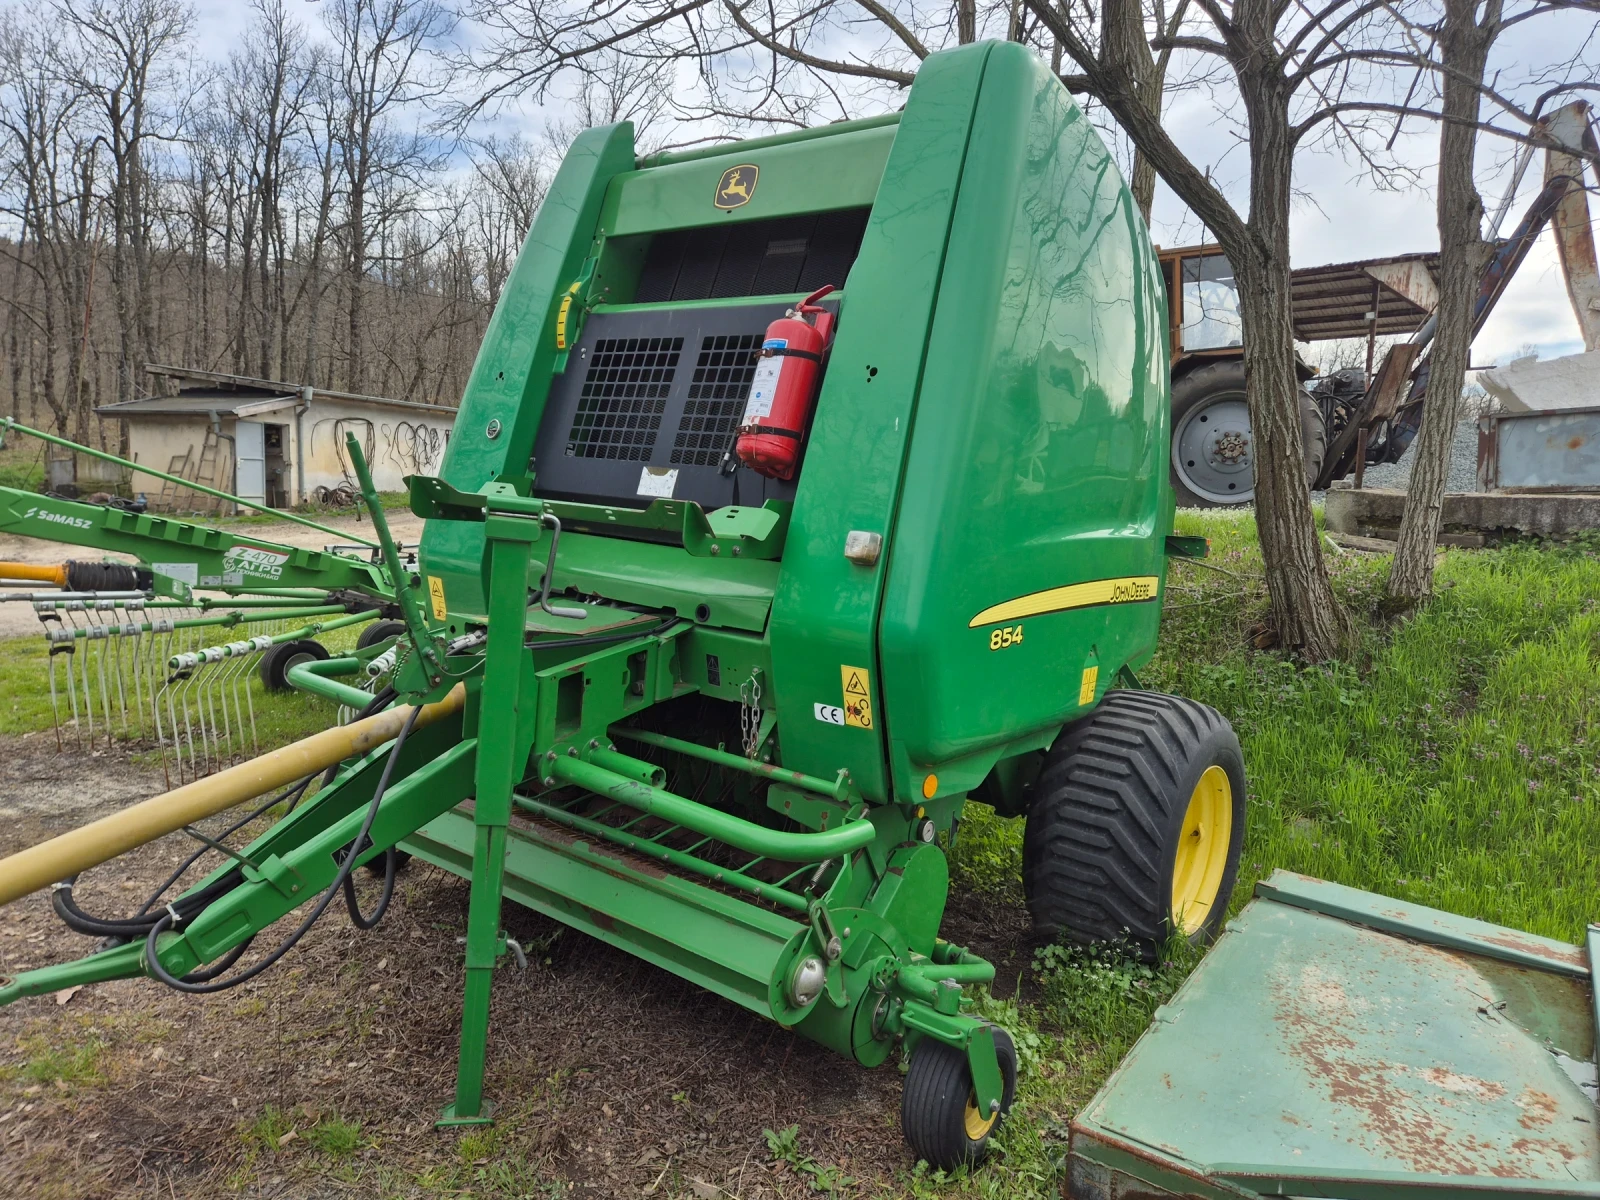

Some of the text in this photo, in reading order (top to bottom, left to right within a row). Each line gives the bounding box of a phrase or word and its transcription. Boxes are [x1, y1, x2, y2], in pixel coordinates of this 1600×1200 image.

[37, 510, 93, 529] SaMASZ
[235, 548, 278, 565] Z-470
[237, 560, 283, 576] АГРО
[1110, 581, 1150, 602] JOHN DEERE
[990, 624, 1024, 651] 854
[820, 706, 839, 723] CE
